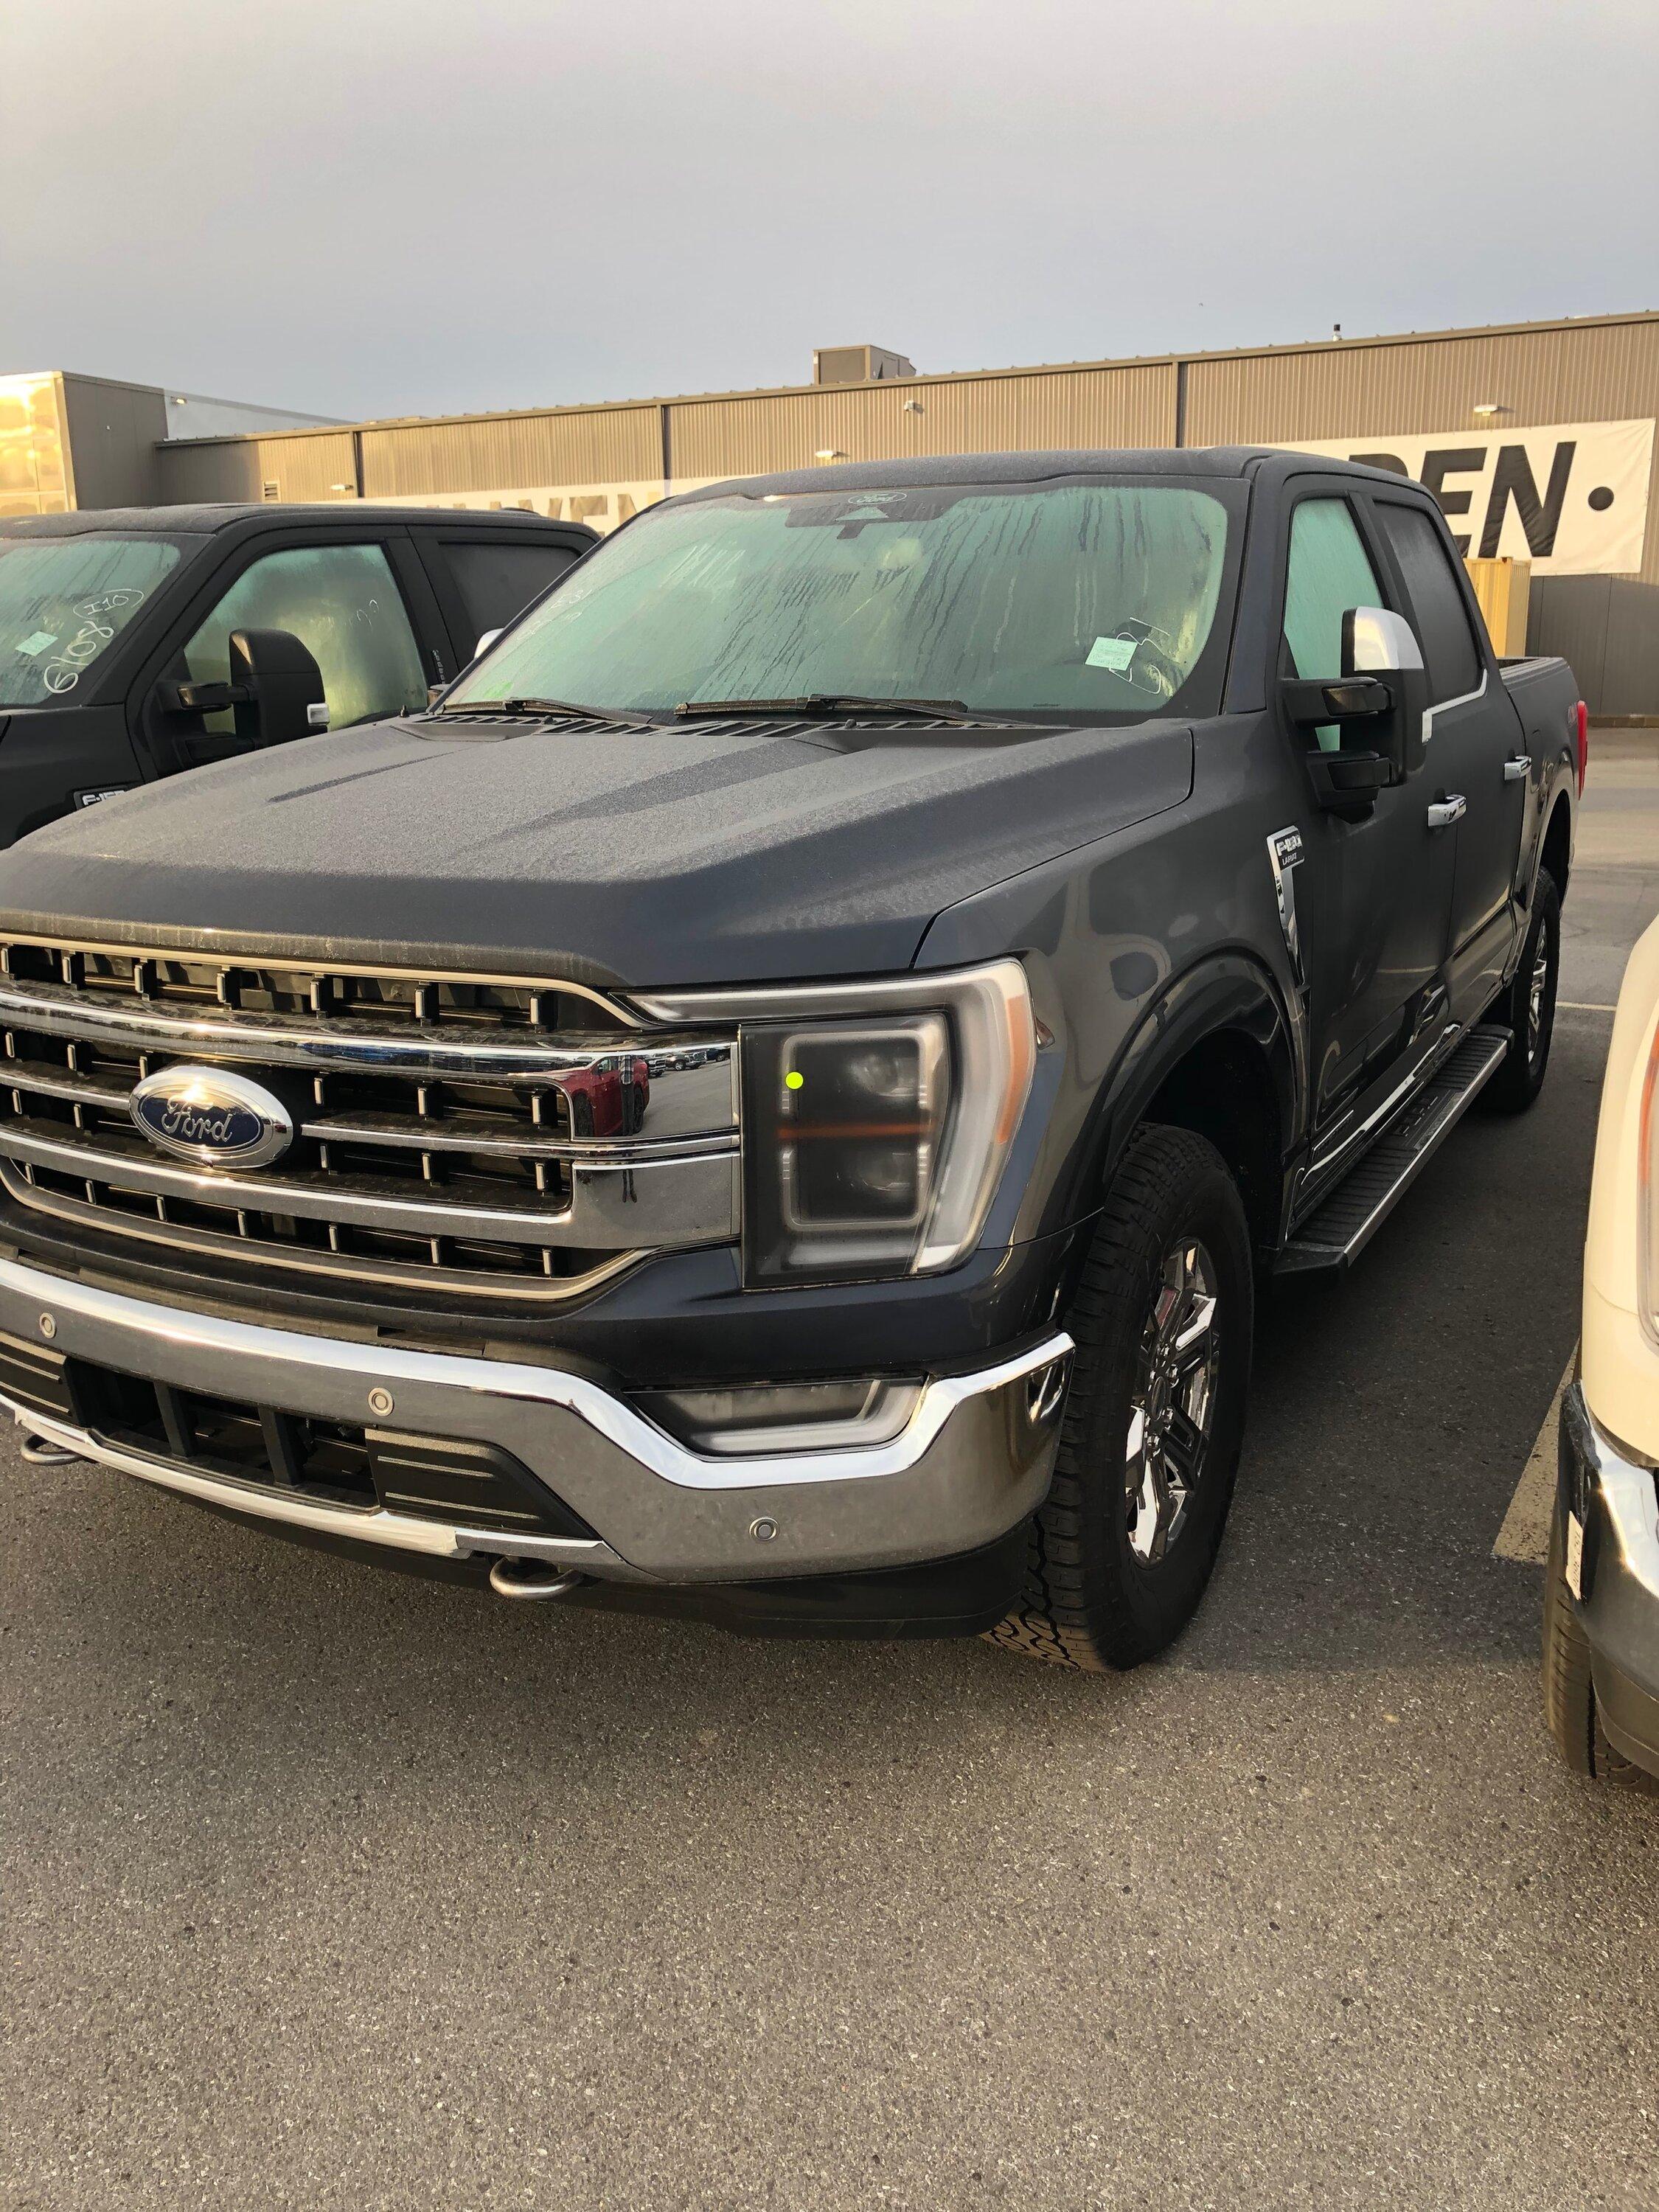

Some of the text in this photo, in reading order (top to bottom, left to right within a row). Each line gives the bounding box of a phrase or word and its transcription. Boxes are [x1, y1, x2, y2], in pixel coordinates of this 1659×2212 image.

[1349, 440, 1577, 558] EN
[82, 790, 125, 806] F-1
[161, 1093, 234, 1143] Ford
